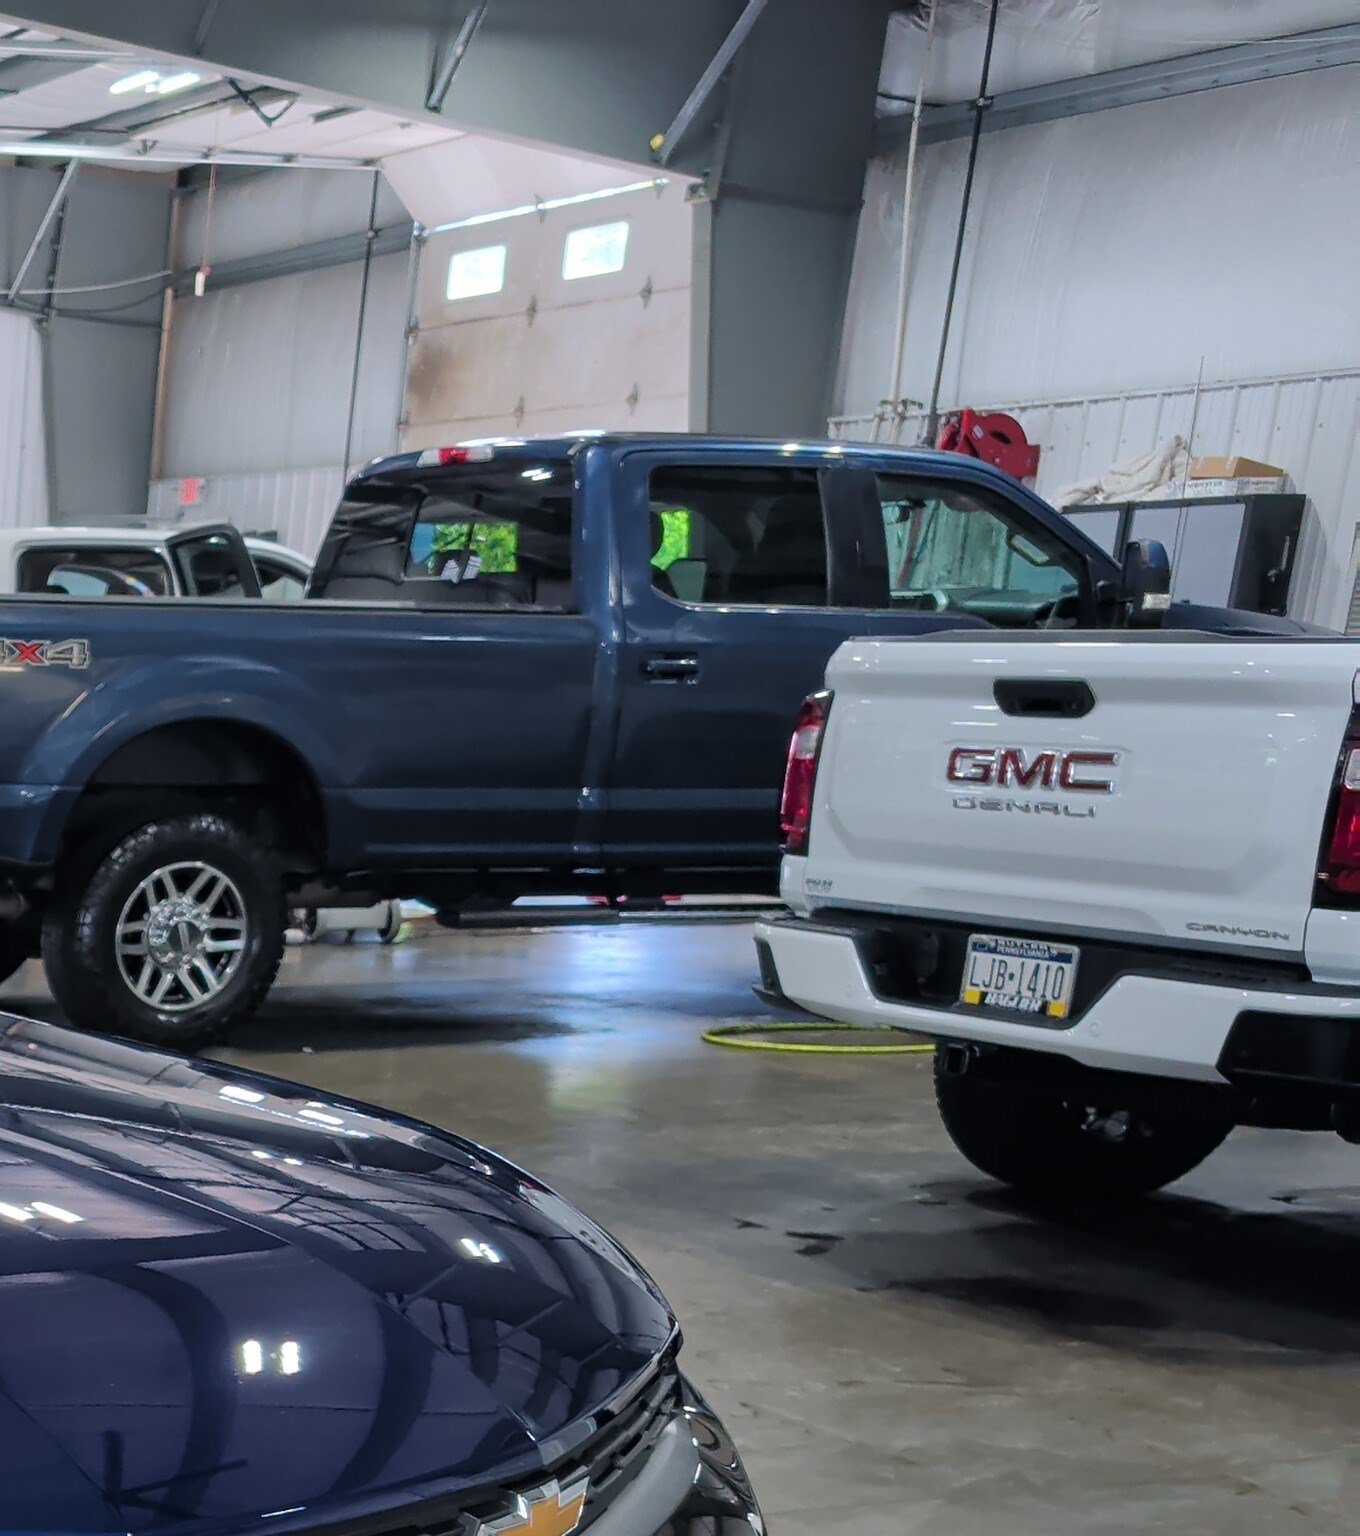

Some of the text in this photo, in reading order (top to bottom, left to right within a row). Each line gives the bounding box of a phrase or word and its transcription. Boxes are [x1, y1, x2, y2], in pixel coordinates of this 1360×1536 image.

[947, 747, 1121, 795] GMC
[952, 797, 1096, 818] DENALI
[1185, 922, 1291, 941] CANYON
